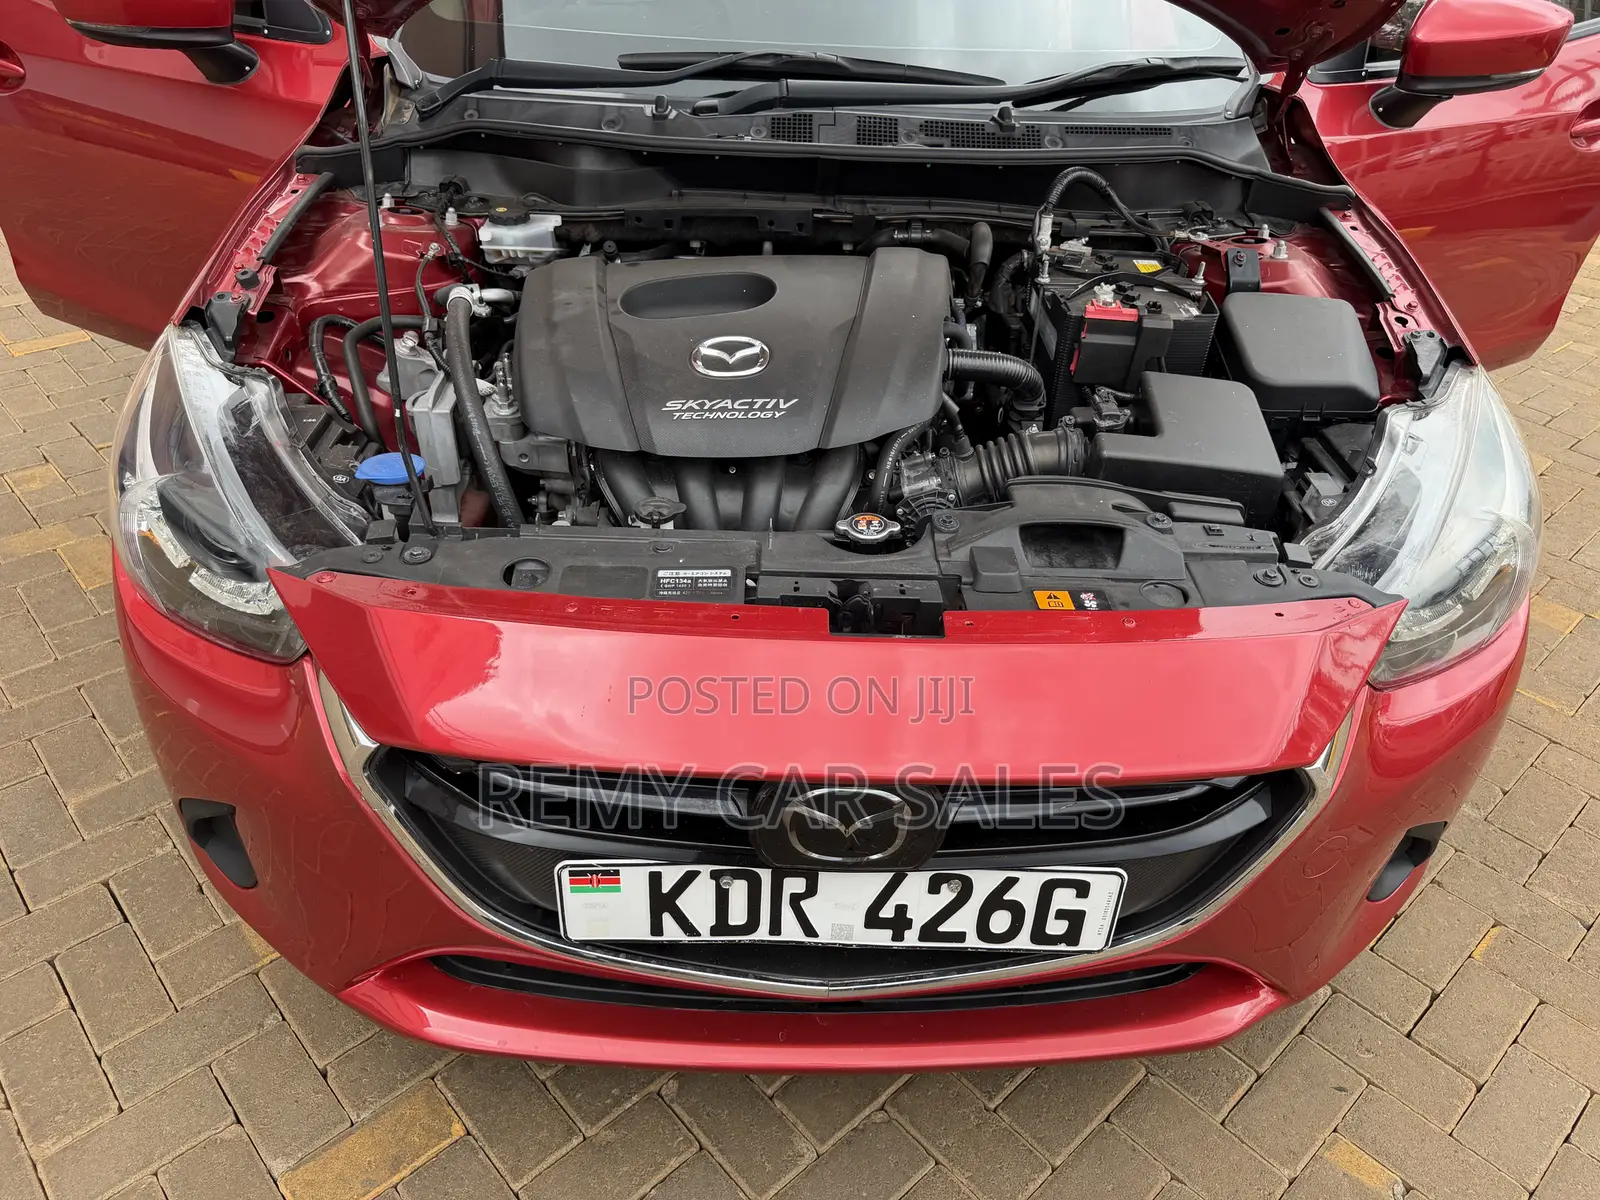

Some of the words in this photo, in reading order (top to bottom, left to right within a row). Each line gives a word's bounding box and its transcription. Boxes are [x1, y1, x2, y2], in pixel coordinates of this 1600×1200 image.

[661, 398, 799, 411] SKYACTIV
[672, 411, 786, 420] TECHNOLOGY
[648, 868, 820, 938] KDR
[863, 871, 1091, 947] 426G
